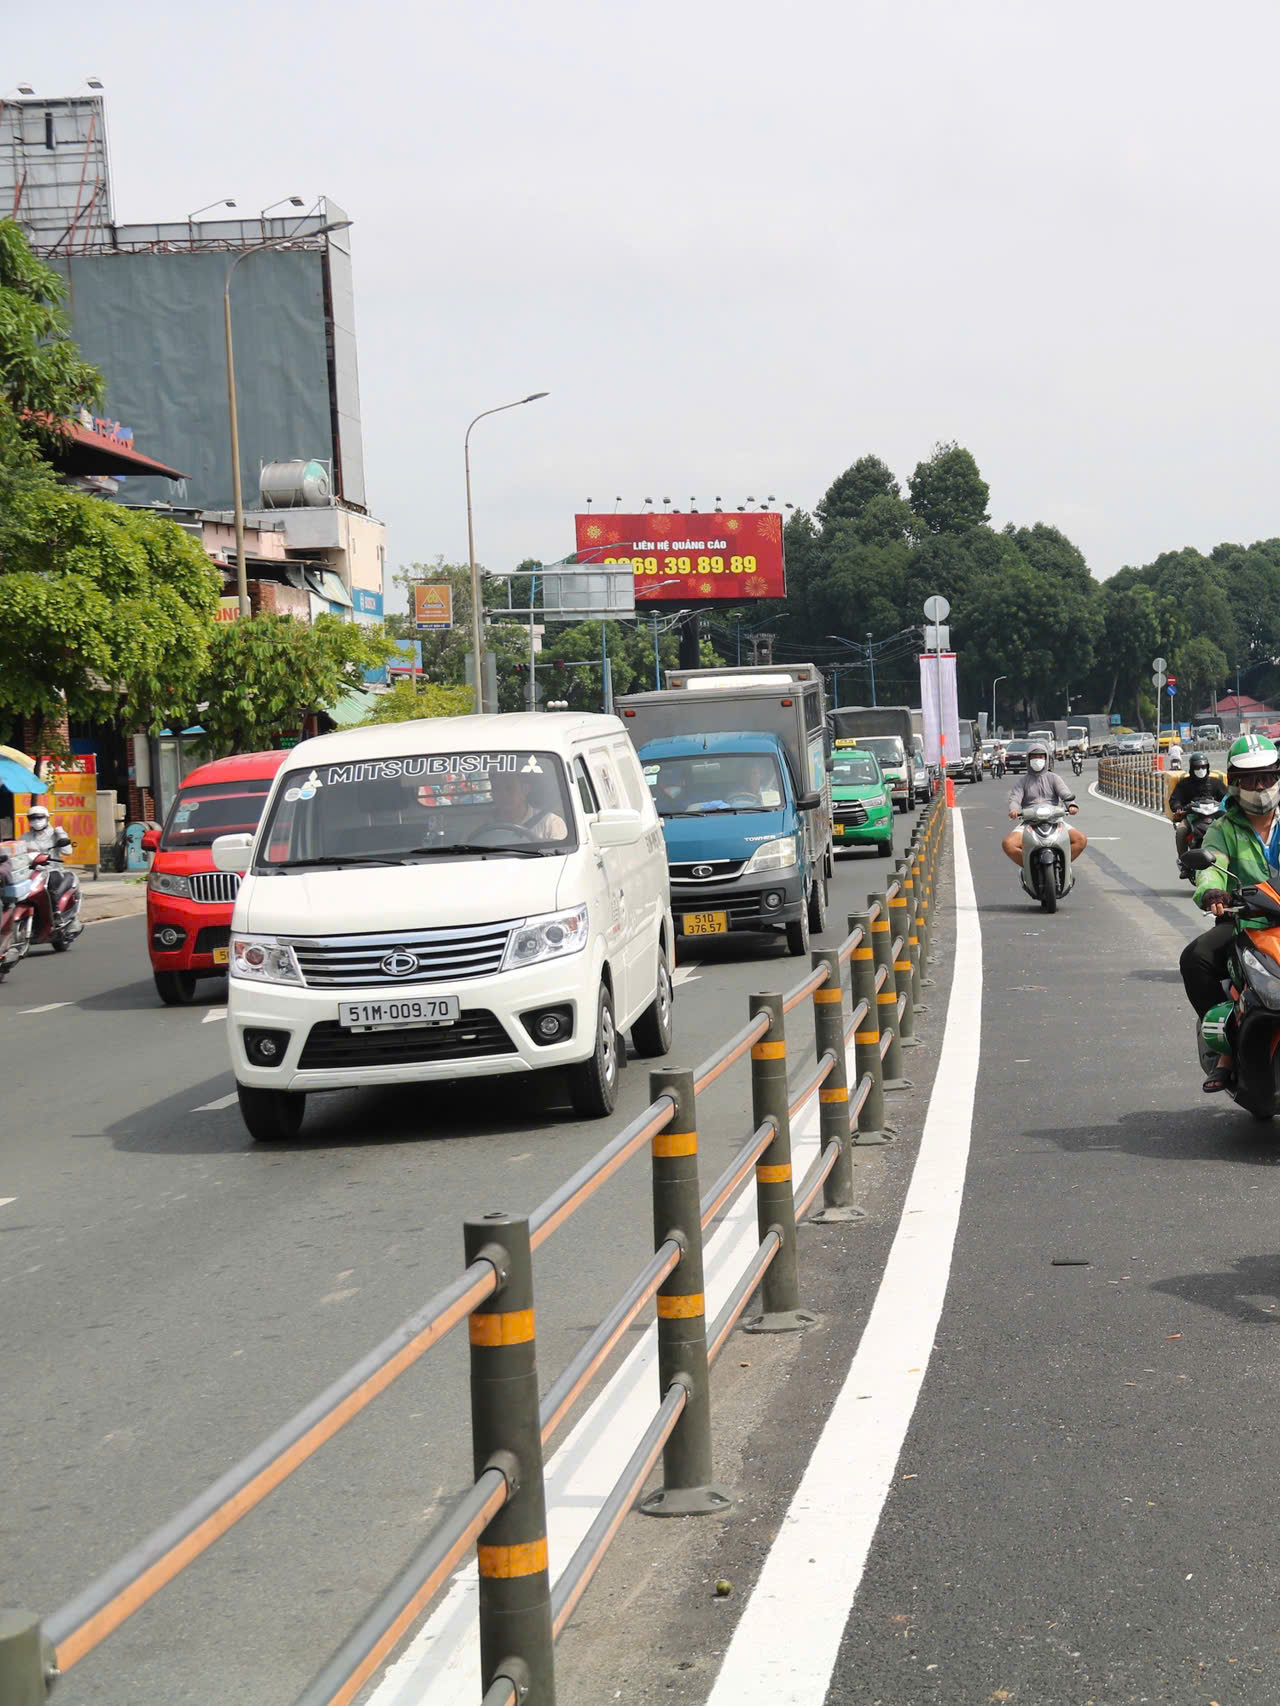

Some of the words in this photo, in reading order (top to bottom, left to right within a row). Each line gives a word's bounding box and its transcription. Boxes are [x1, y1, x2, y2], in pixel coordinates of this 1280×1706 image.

[633, 540, 655, 550] LIÊN
[657, 540, 669, 551] HỆ
[672, 539, 705, 551] QUẢNG
[707, 539, 727, 549] CÁO
[328, 754, 517, 785] MITSUBISHI
[688, 923, 722, 934] 376.57
[349, 1001, 449, 1021] 51M-009.70
